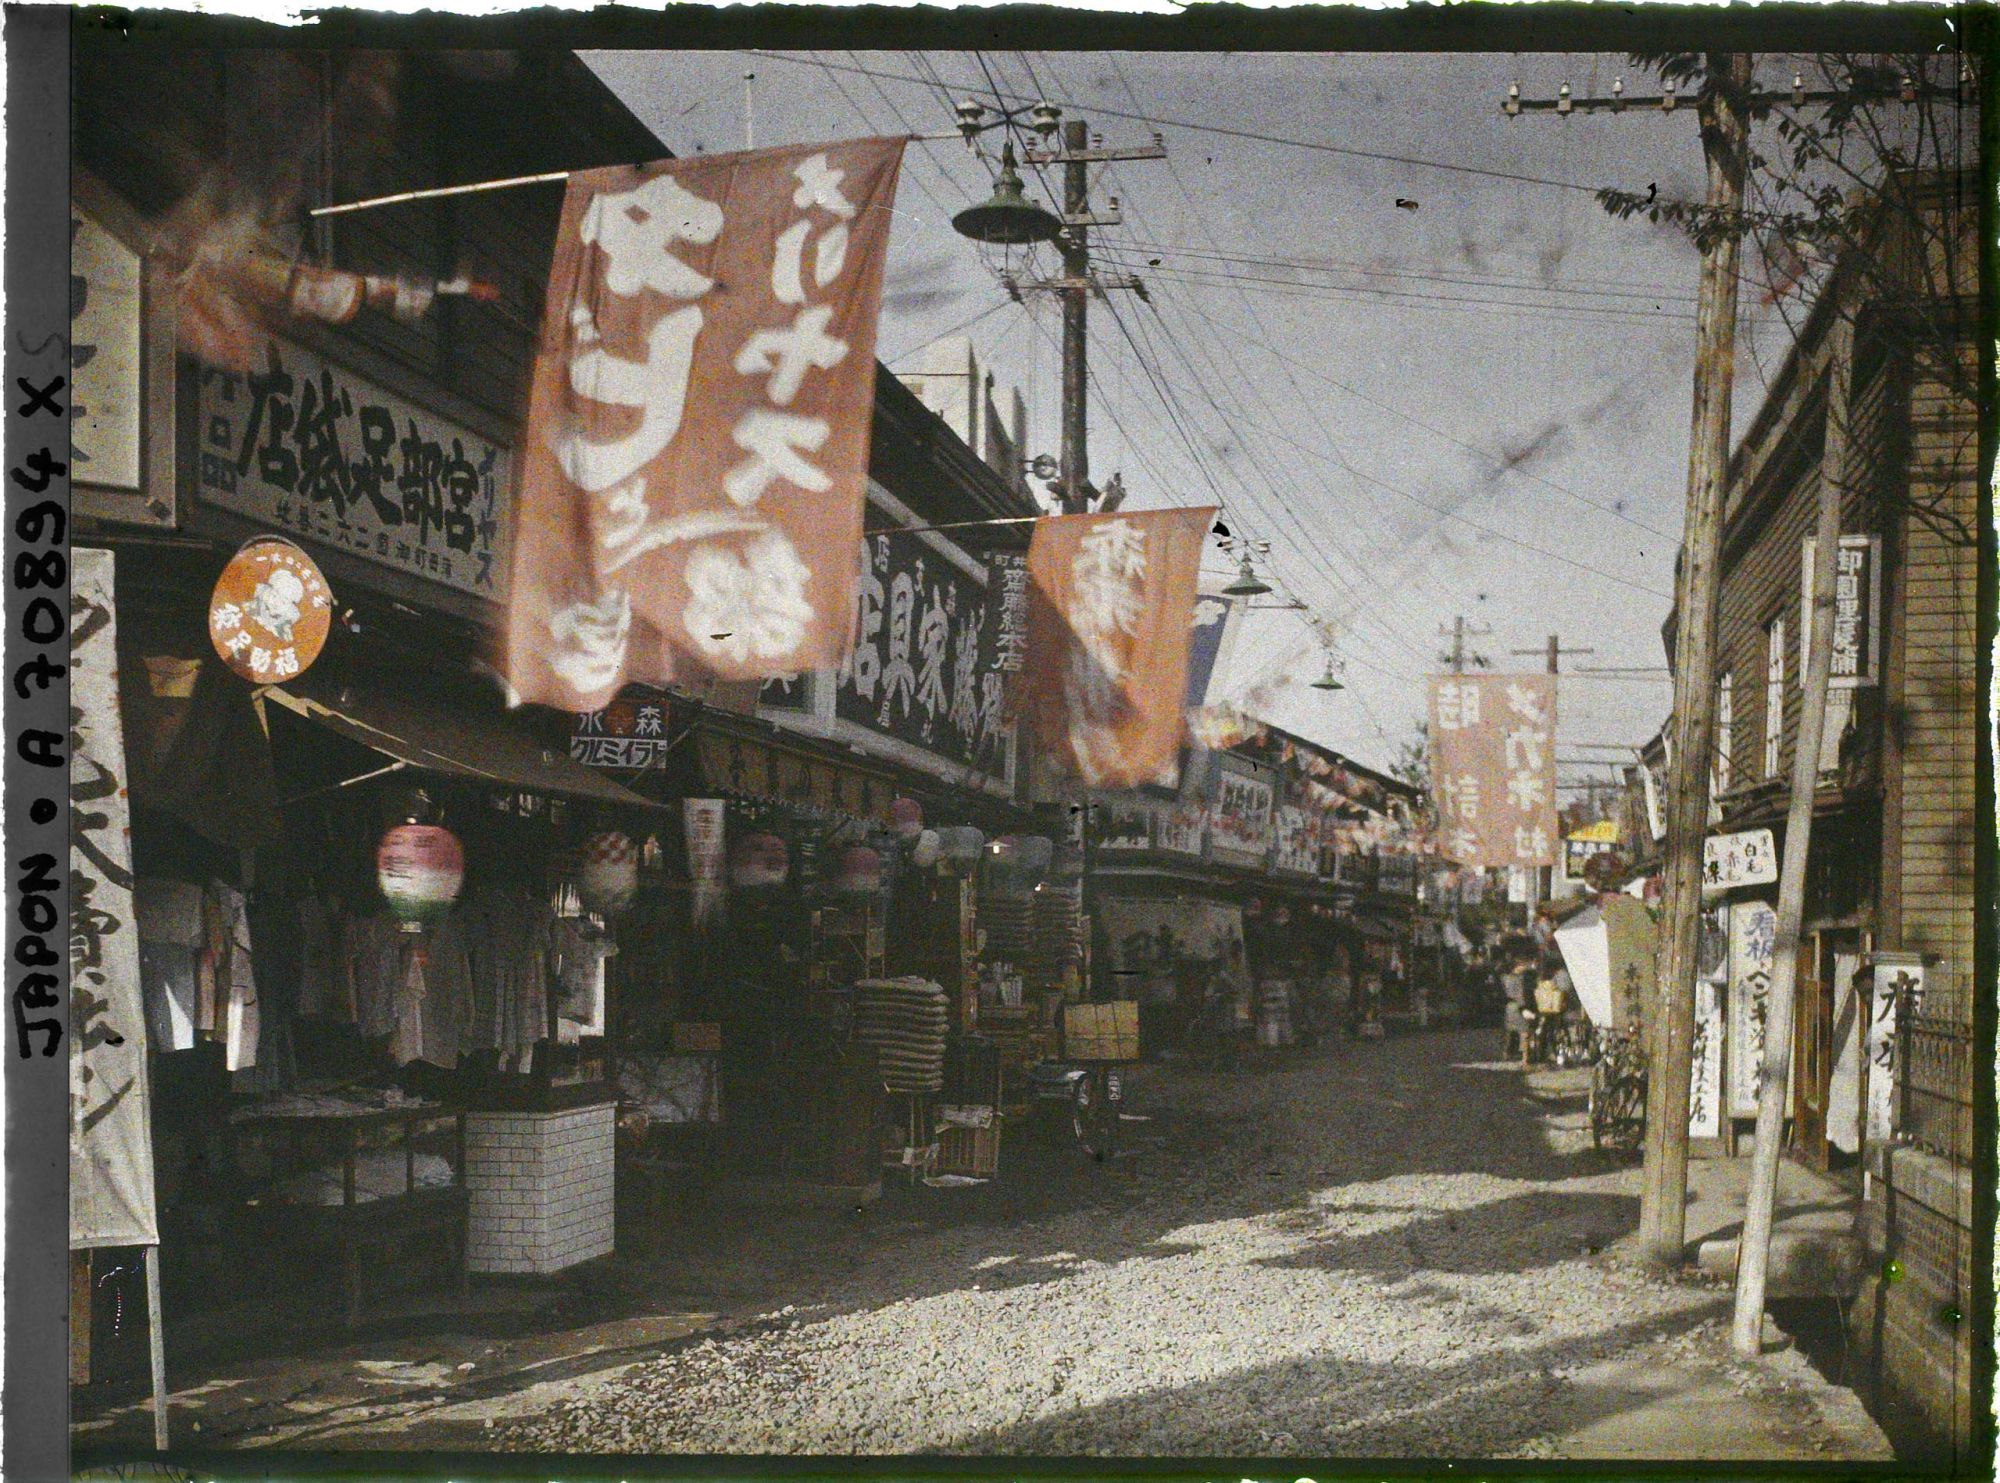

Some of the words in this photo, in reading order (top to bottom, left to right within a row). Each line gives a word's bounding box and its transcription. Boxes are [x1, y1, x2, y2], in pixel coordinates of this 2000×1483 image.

[475, 446, 498, 588] メリヤス
[213, 602, 299, 676] 福助足袋
[573, 738, 667, 767] ドライミルク
